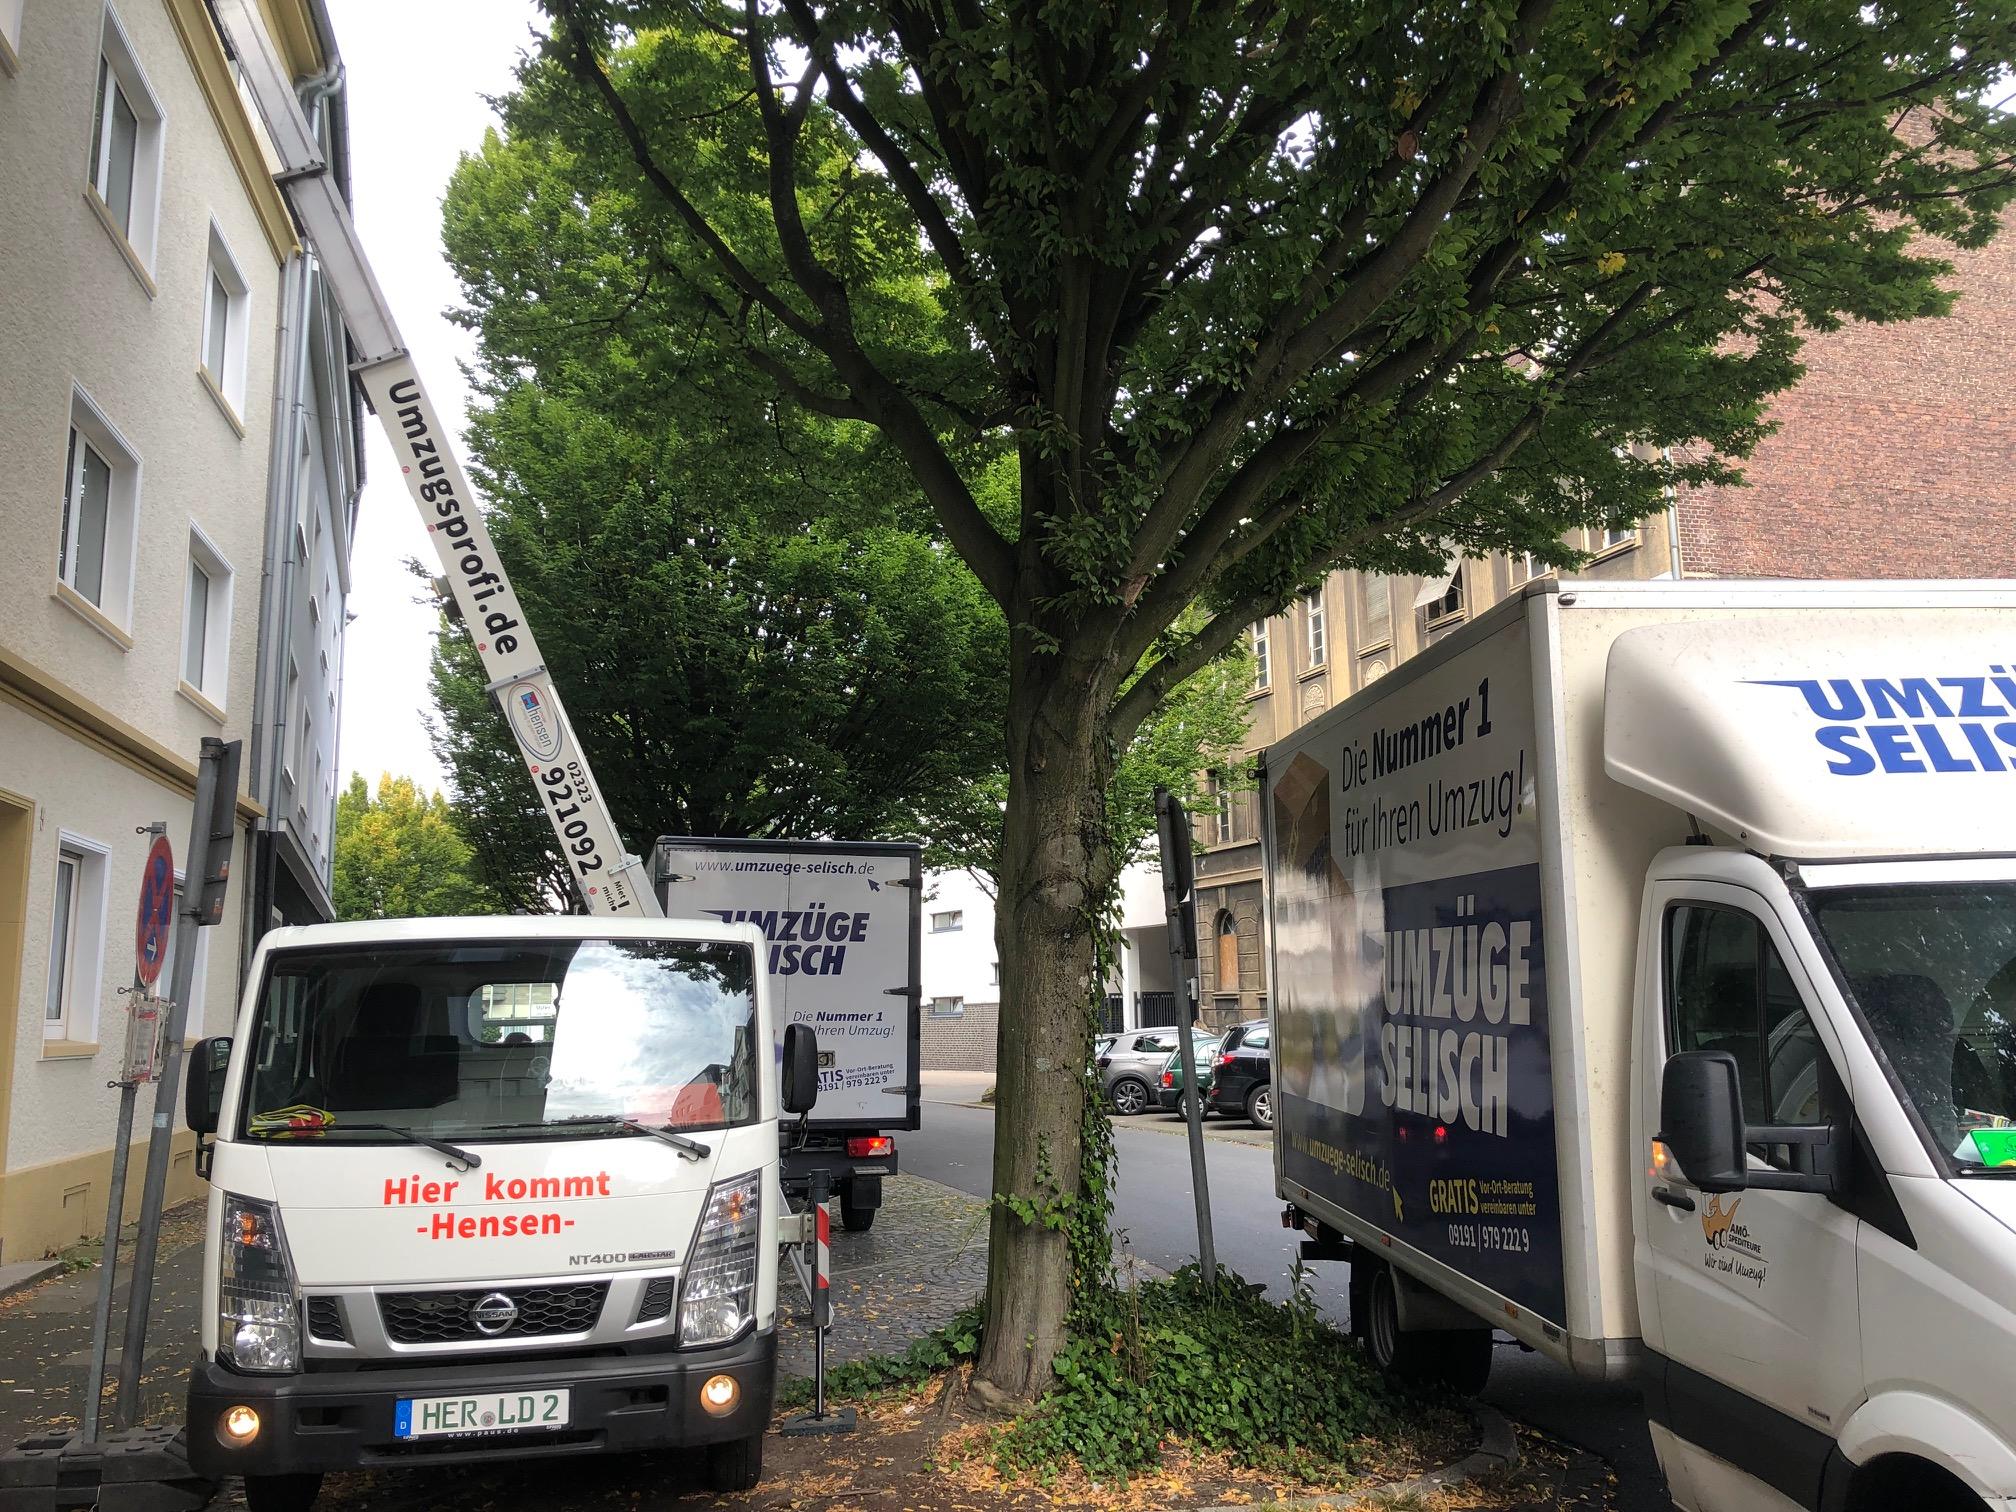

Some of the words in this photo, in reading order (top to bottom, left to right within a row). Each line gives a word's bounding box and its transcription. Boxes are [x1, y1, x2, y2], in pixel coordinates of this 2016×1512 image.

[389, 379, 518, 655] Umzugsprofi.de
[1342, 740, 1368, 792] Die
[1372, 697, 1470, 780] Nummer
[1477, 677, 1492, 738] 1
[567, 761, 592, 804] 02323
[1345, 807, 1368, 858] für
[1372, 797, 1420, 851] Ihren
[1428, 749, 1524, 838] Umzug!
[541, 767, 603, 876] 921092
[695, 861, 875, 876] www.umzuege-selisch.de
[768, 944, 846, 976] ISCH
[1383, 894, 1531, 1026] UMZÜGE
[793, 1011, 813, 1022] Die
[816, 1011, 873, 1022] Nummer
[876, 1011, 883, 1022] 1
[848, 1025, 896, 1039] Umzug!
[817, 1082, 839, 1092] 9191
[846, 1078, 863, 1088] 979
[864, 1076, 881, 1086] 222
[882, 1075, 888, 1083] 9
[1381, 1022, 1508, 1138] SELISCH
[384, 1174, 459, 1205] Hier
[485, 1171, 611, 1200] kommt
[1429, 1178, 1479, 1214] GRATIS
[417, 1212, 575, 1240] -Hensen-
[1448, 1223, 1476, 1248] 09191
[1482, 1225, 1500, 1250] 979
[1501, 1226, 1521, 1252] 222
[1522, 1228, 1529, 1253] 9
[569, 1252, 627, 1266] NT400
[1728, 1234, 1762, 1254] SPEDITEURE
[1704, 1253, 1717, 1269] Wir
[400, 1421, 407, 1430] D
[422, 1400, 478, 1430] HER
[498, 1396, 535, 1425] LD
[542, 1394, 559, 1421] 2
[447, 1427, 519, 1438] www.paus.de
